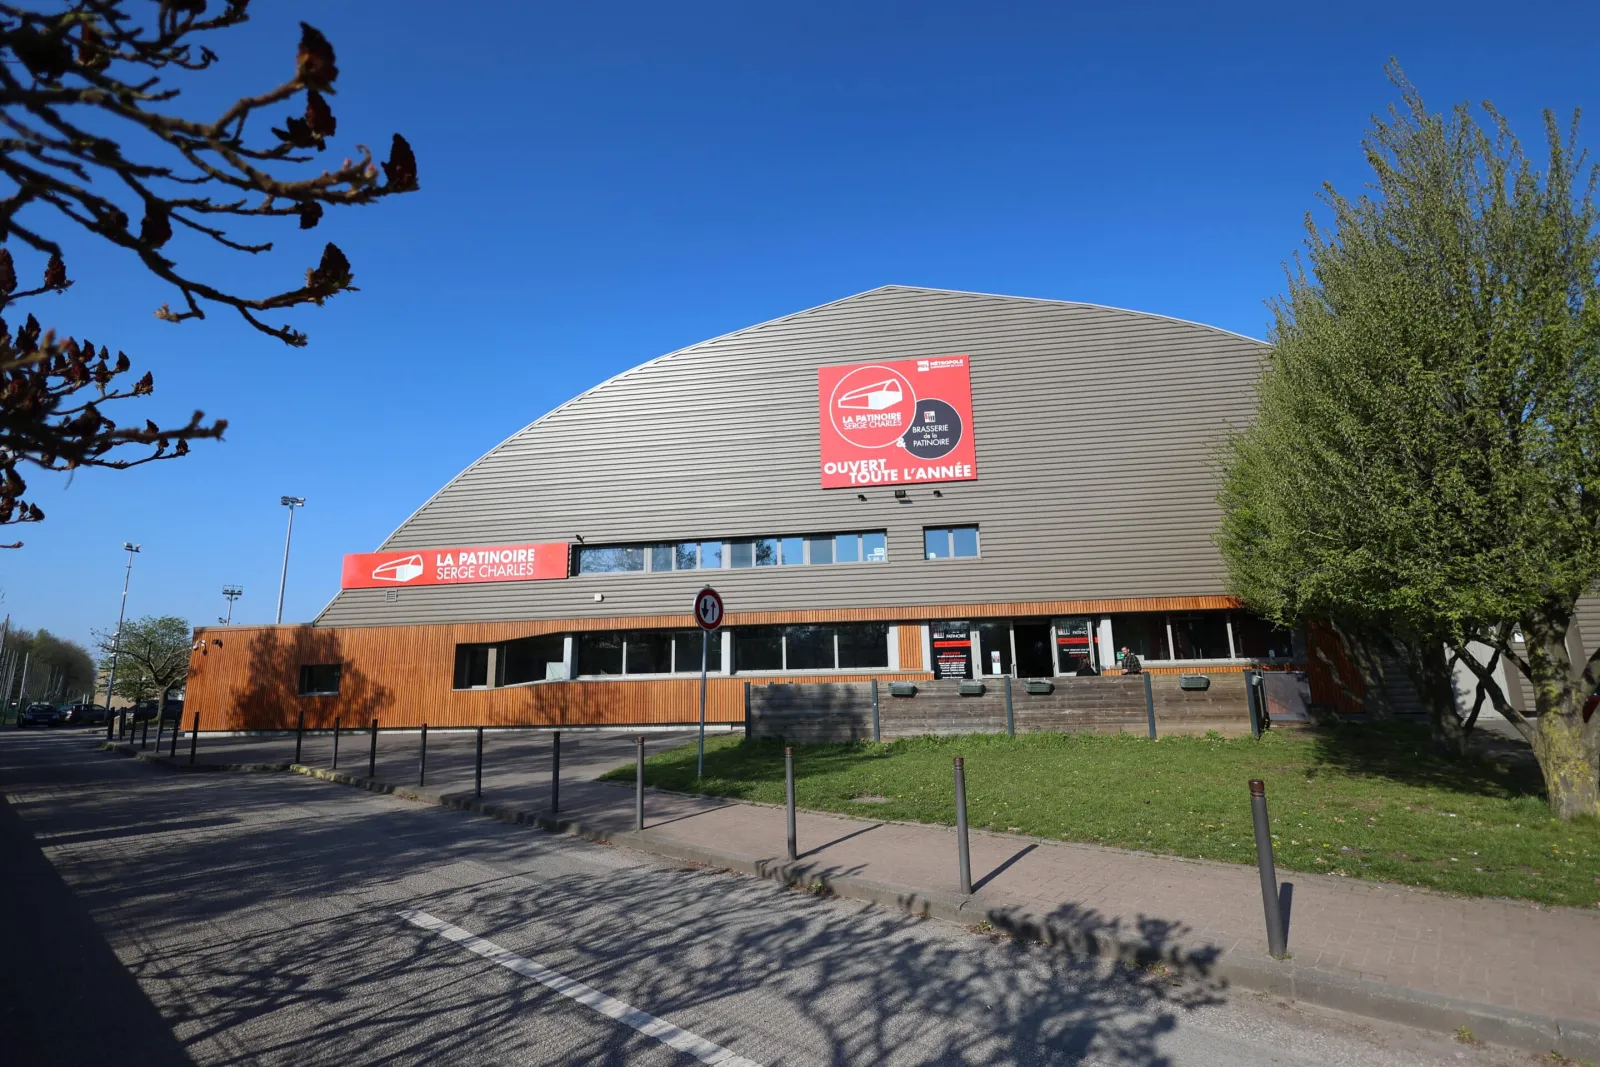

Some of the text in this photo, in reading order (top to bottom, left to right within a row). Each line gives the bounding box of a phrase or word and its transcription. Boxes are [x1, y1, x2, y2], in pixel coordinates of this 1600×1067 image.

[842, 412, 902, 424] LA PATINOIRE
[843, 418, 902, 430] SERGE CHARLES
[912, 424, 949, 433] BRASSERIE
[896, 437, 906, 448] &
[913, 438, 950, 447] PATINOIRE
[824, 458, 887, 475] OUVERT
[849, 462, 972, 484] TOUTE L'ANNÉE
[436, 548, 535, 566] LA PATINOIRE
[436, 563, 534, 580] SERGE CHARLES
